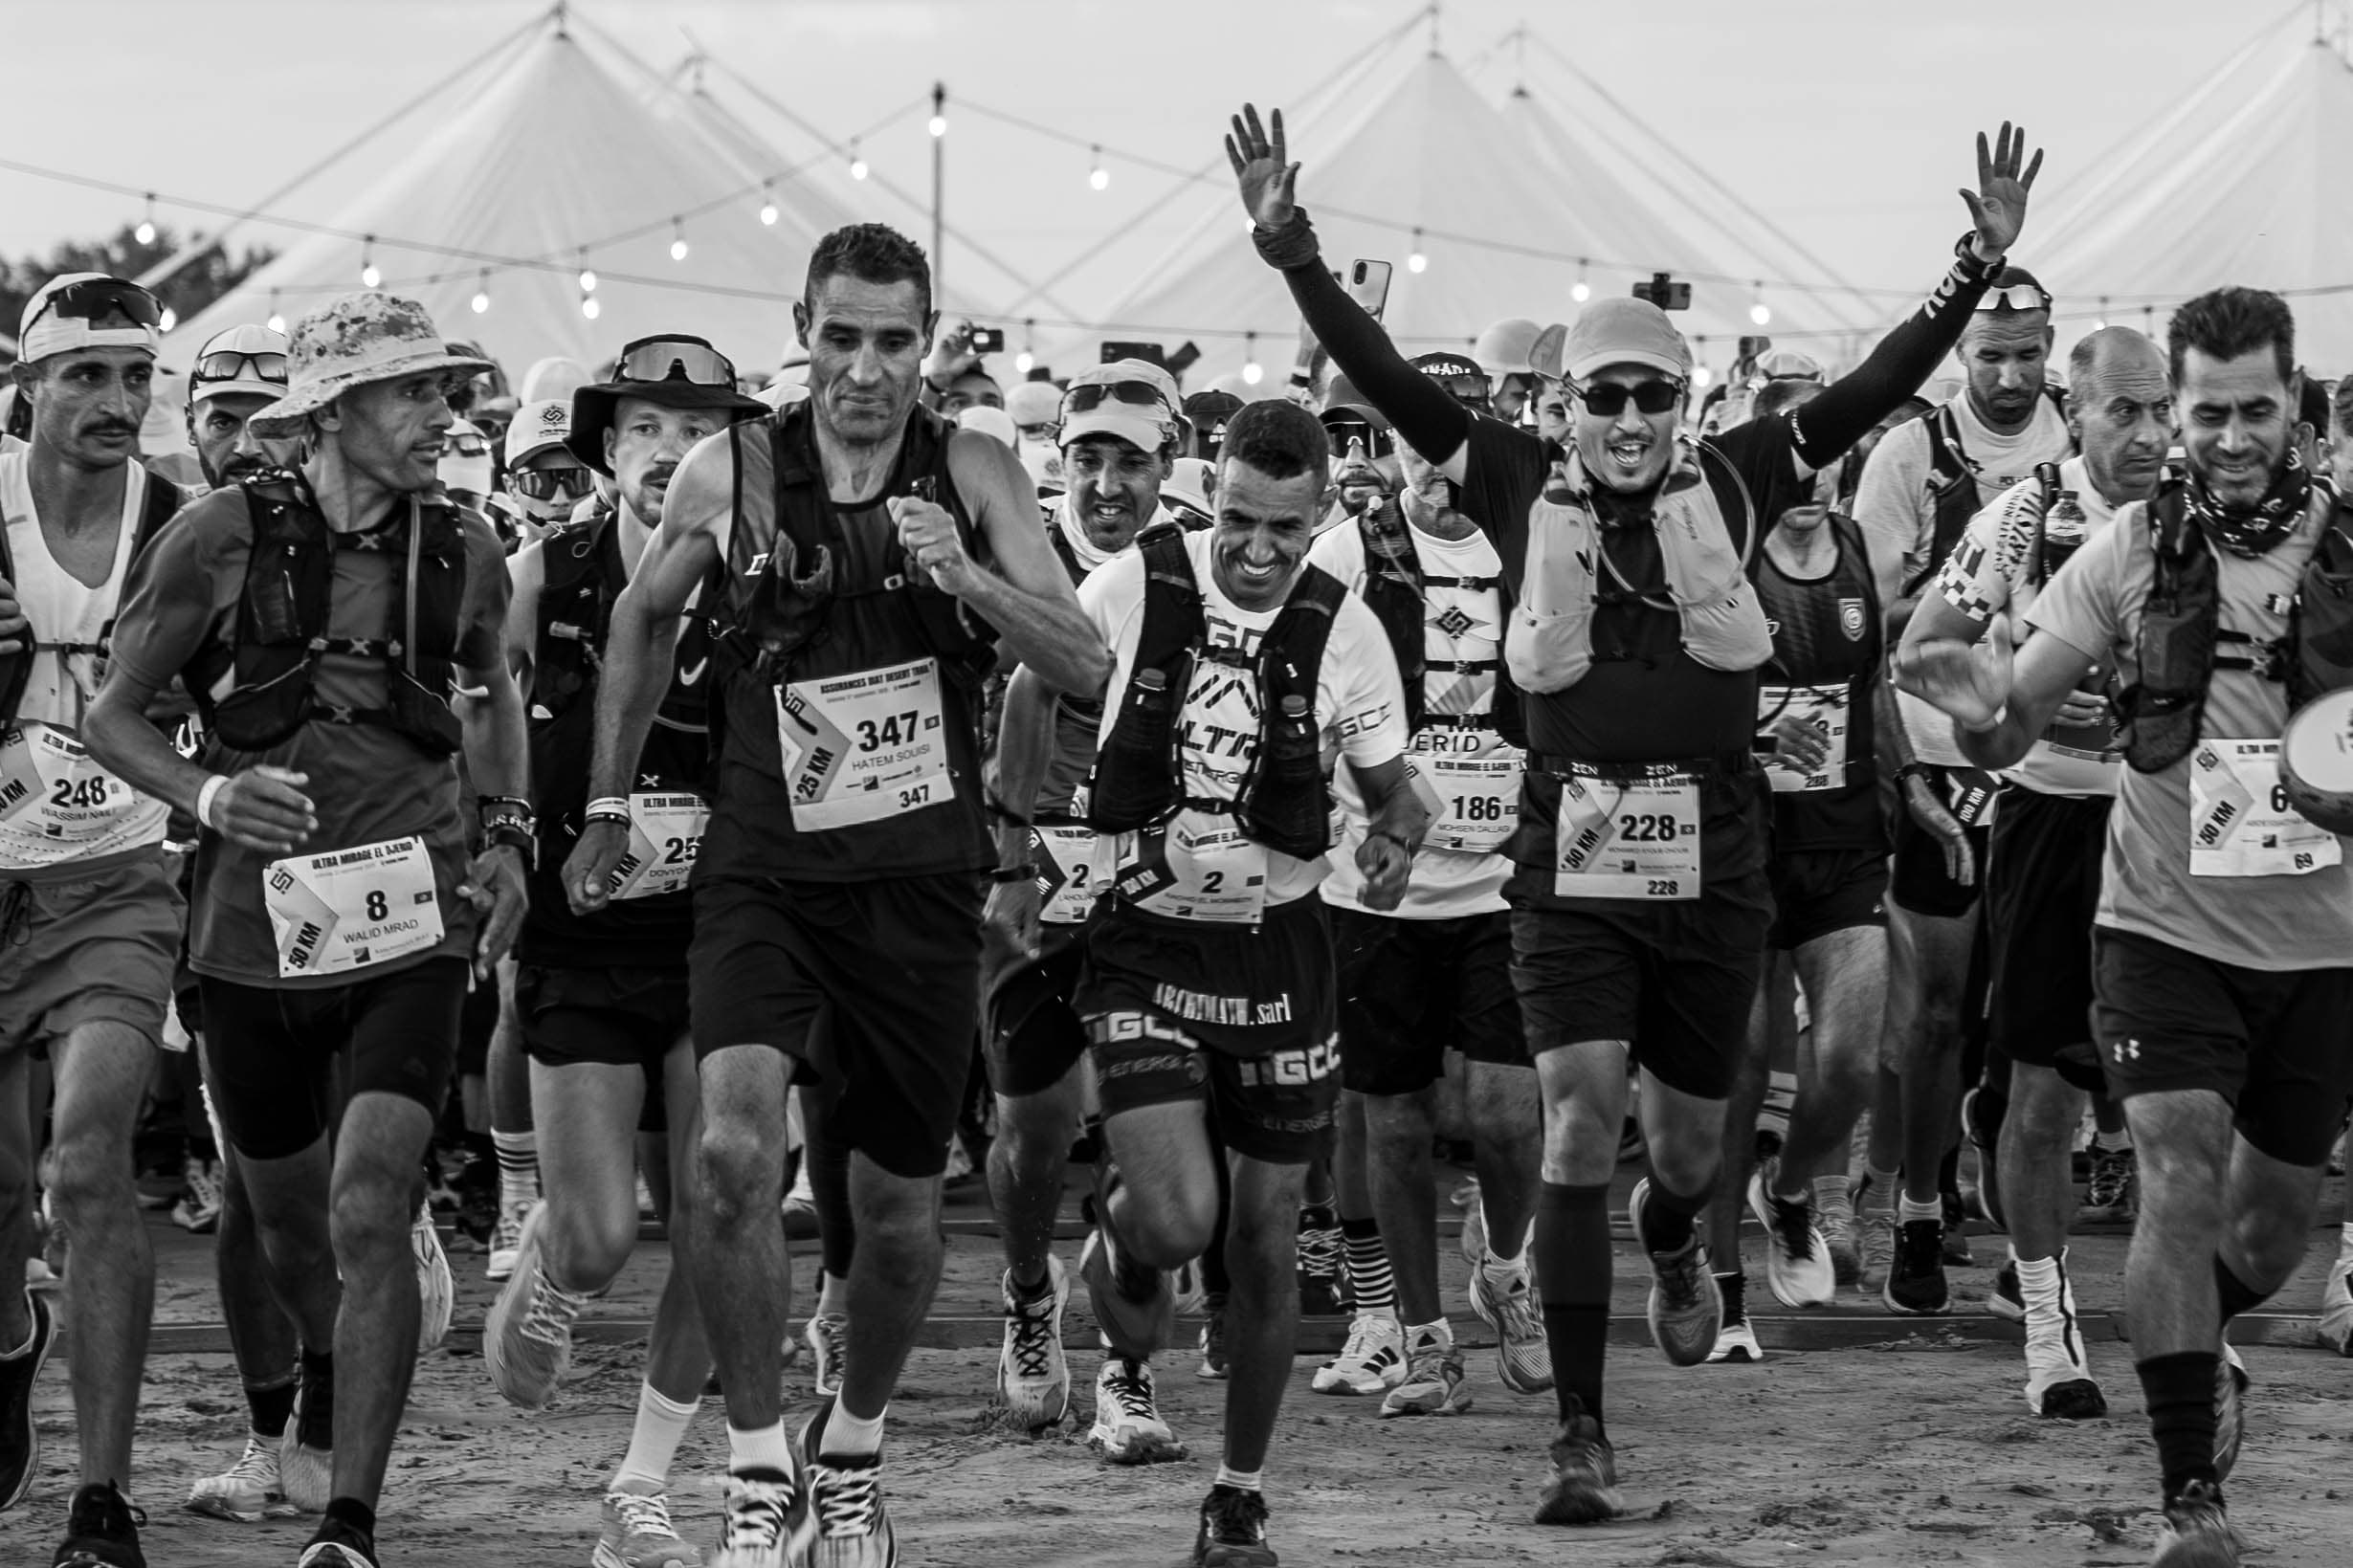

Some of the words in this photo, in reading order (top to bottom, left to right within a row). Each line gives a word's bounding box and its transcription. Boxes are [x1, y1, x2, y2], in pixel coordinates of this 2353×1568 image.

[856, 710, 919, 753] 347
[1414, 734, 1481, 752] ERID
[806, 746, 835, 777] KM
[851, 753, 895, 772] HATEM
[896, 744, 931, 763] SOUISI
[2, 779, 30, 804] KM
[50, 776, 107, 808] 248
[795, 773, 821, 799] 25
[899, 784, 930, 808] 347
[1451, 795, 1501, 822] 186
[1959, 804, 1976, 823] 100
[1968, 786, 1987, 806] KM
[1619, 814, 1676, 842] 228
[2198, 823, 2221, 846] 50
[2210, 800, 2237, 828] KM
[311, 855, 339, 870] ULTRA
[340, 849, 373, 866] MIRAGE
[374, 848, 385, 858] EL
[385, 841, 413, 855] DJERID
[664, 836, 705, 865] 25
[1563, 848, 1586, 870] 50
[1575, 827, 1601, 853] KM
[649, 866, 691, 878] DOVYDA
[1200, 871, 1225, 894] 2
[1647, 879, 1678, 895] 228
[365, 889, 389, 922] 8
[288, 946, 310, 969] 50
[299, 921, 322, 950] KM
[343, 926, 382, 944] WALID
[384, 918, 419, 936] MRAD
